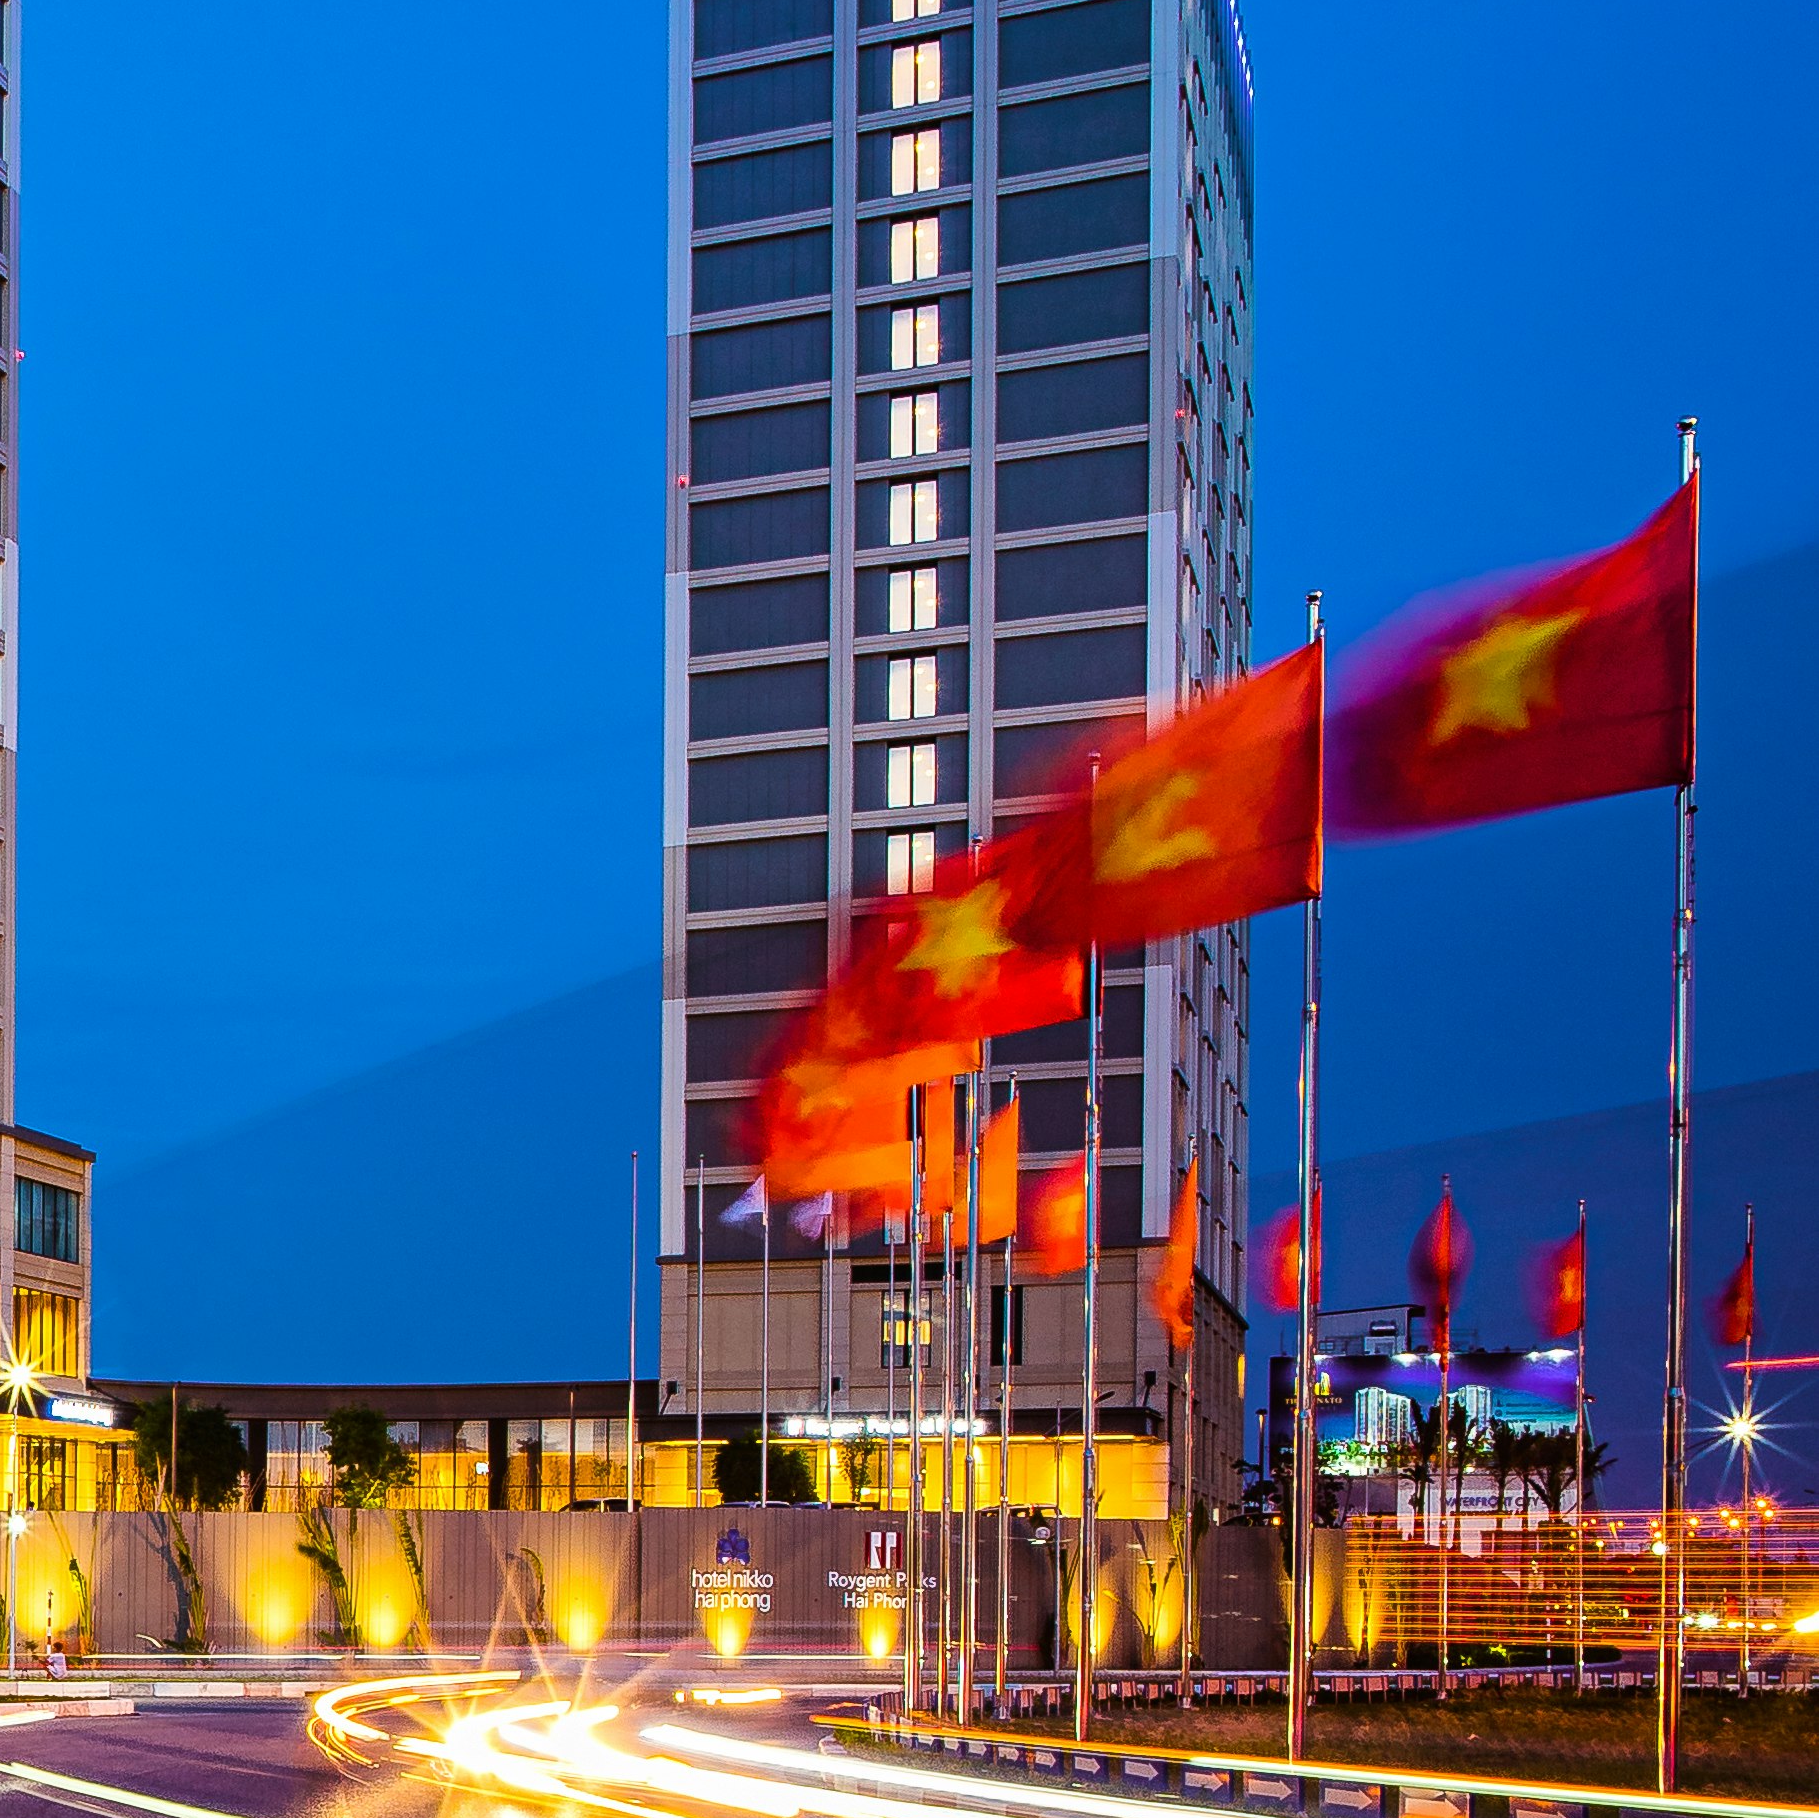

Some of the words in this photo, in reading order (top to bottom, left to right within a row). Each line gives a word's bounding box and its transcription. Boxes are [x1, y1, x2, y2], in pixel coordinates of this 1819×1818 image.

[1515, 1496, 1539, 1507] CTY
[692, 1568, 731, 1588] hotel
[733, 1569, 774, 1588] nikko
[828, 1571, 892, 1592] Roygent
[896, 1571, 937, 1588] Pks
[695, 1589, 719, 1609] hai
[721, 1589, 771, 1613] phong
[843, 1592, 869, 1608] Hai
[873, 1592, 907, 1609] Phon
